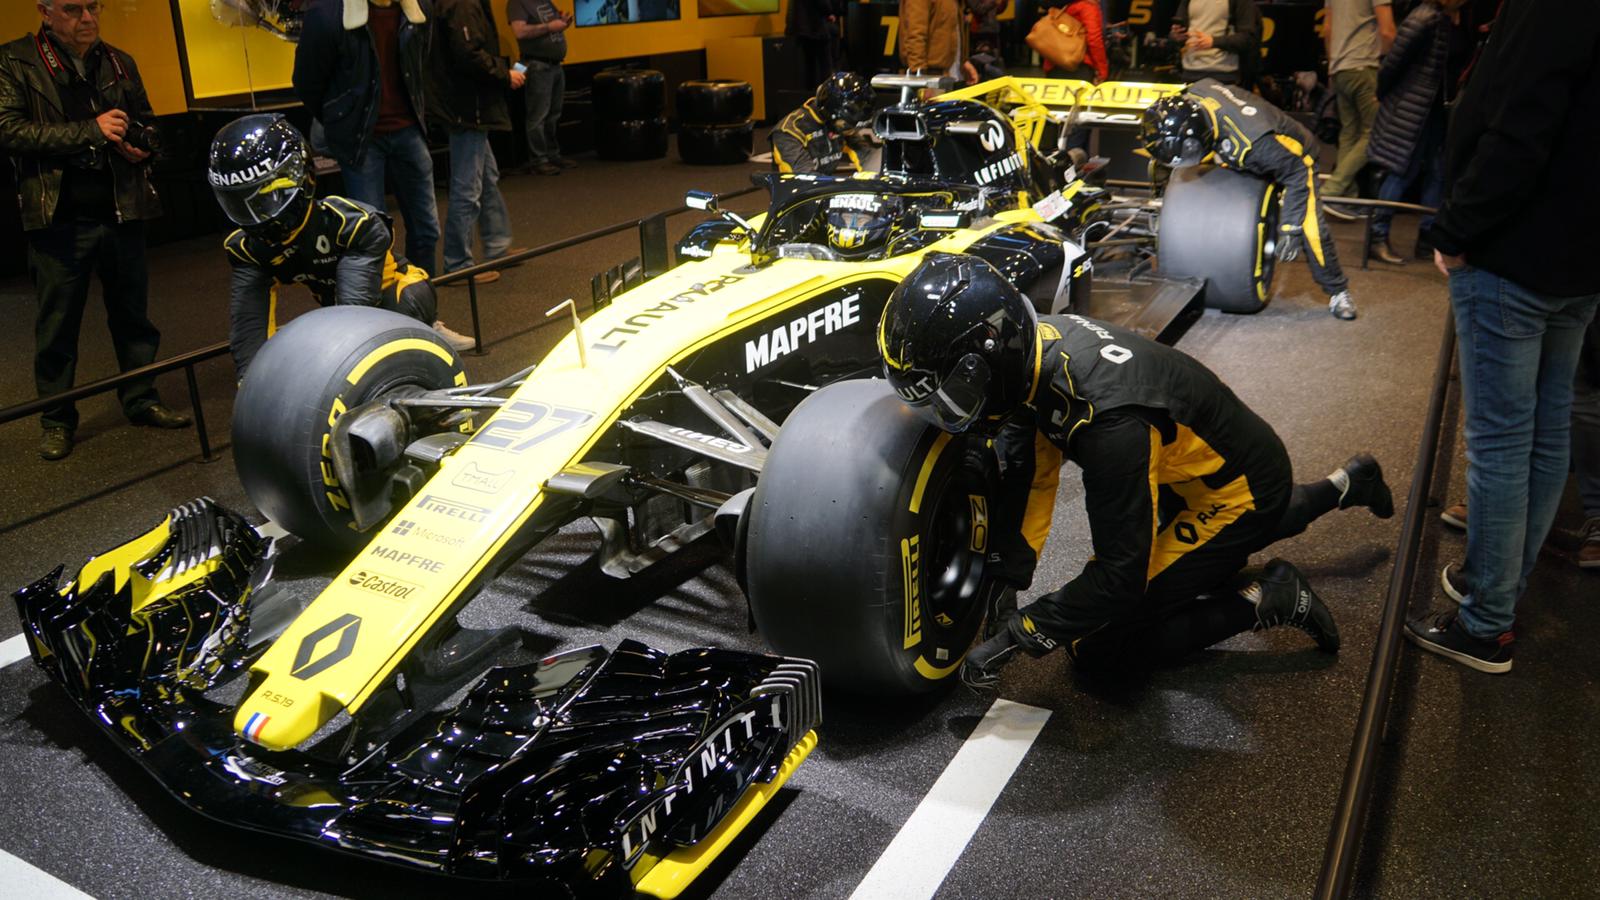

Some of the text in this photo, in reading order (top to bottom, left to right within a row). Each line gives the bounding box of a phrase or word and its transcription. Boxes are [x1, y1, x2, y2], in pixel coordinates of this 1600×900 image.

[1021, 84, 1173, 105] RENAULT
[745, 293, 860, 374] MAPFRE
[466, 399, 600, 454] 27
[416, 494, 492, 523] PIRELLI
[412, 526, 465, 548] Microsoft
[371, 545, 445, 573] MAPFRE
[362, 575, 416, 599] Castrol
[900, 534, 922, 650] PIRELLI
[1298, 590, 1310, 613] OMP
